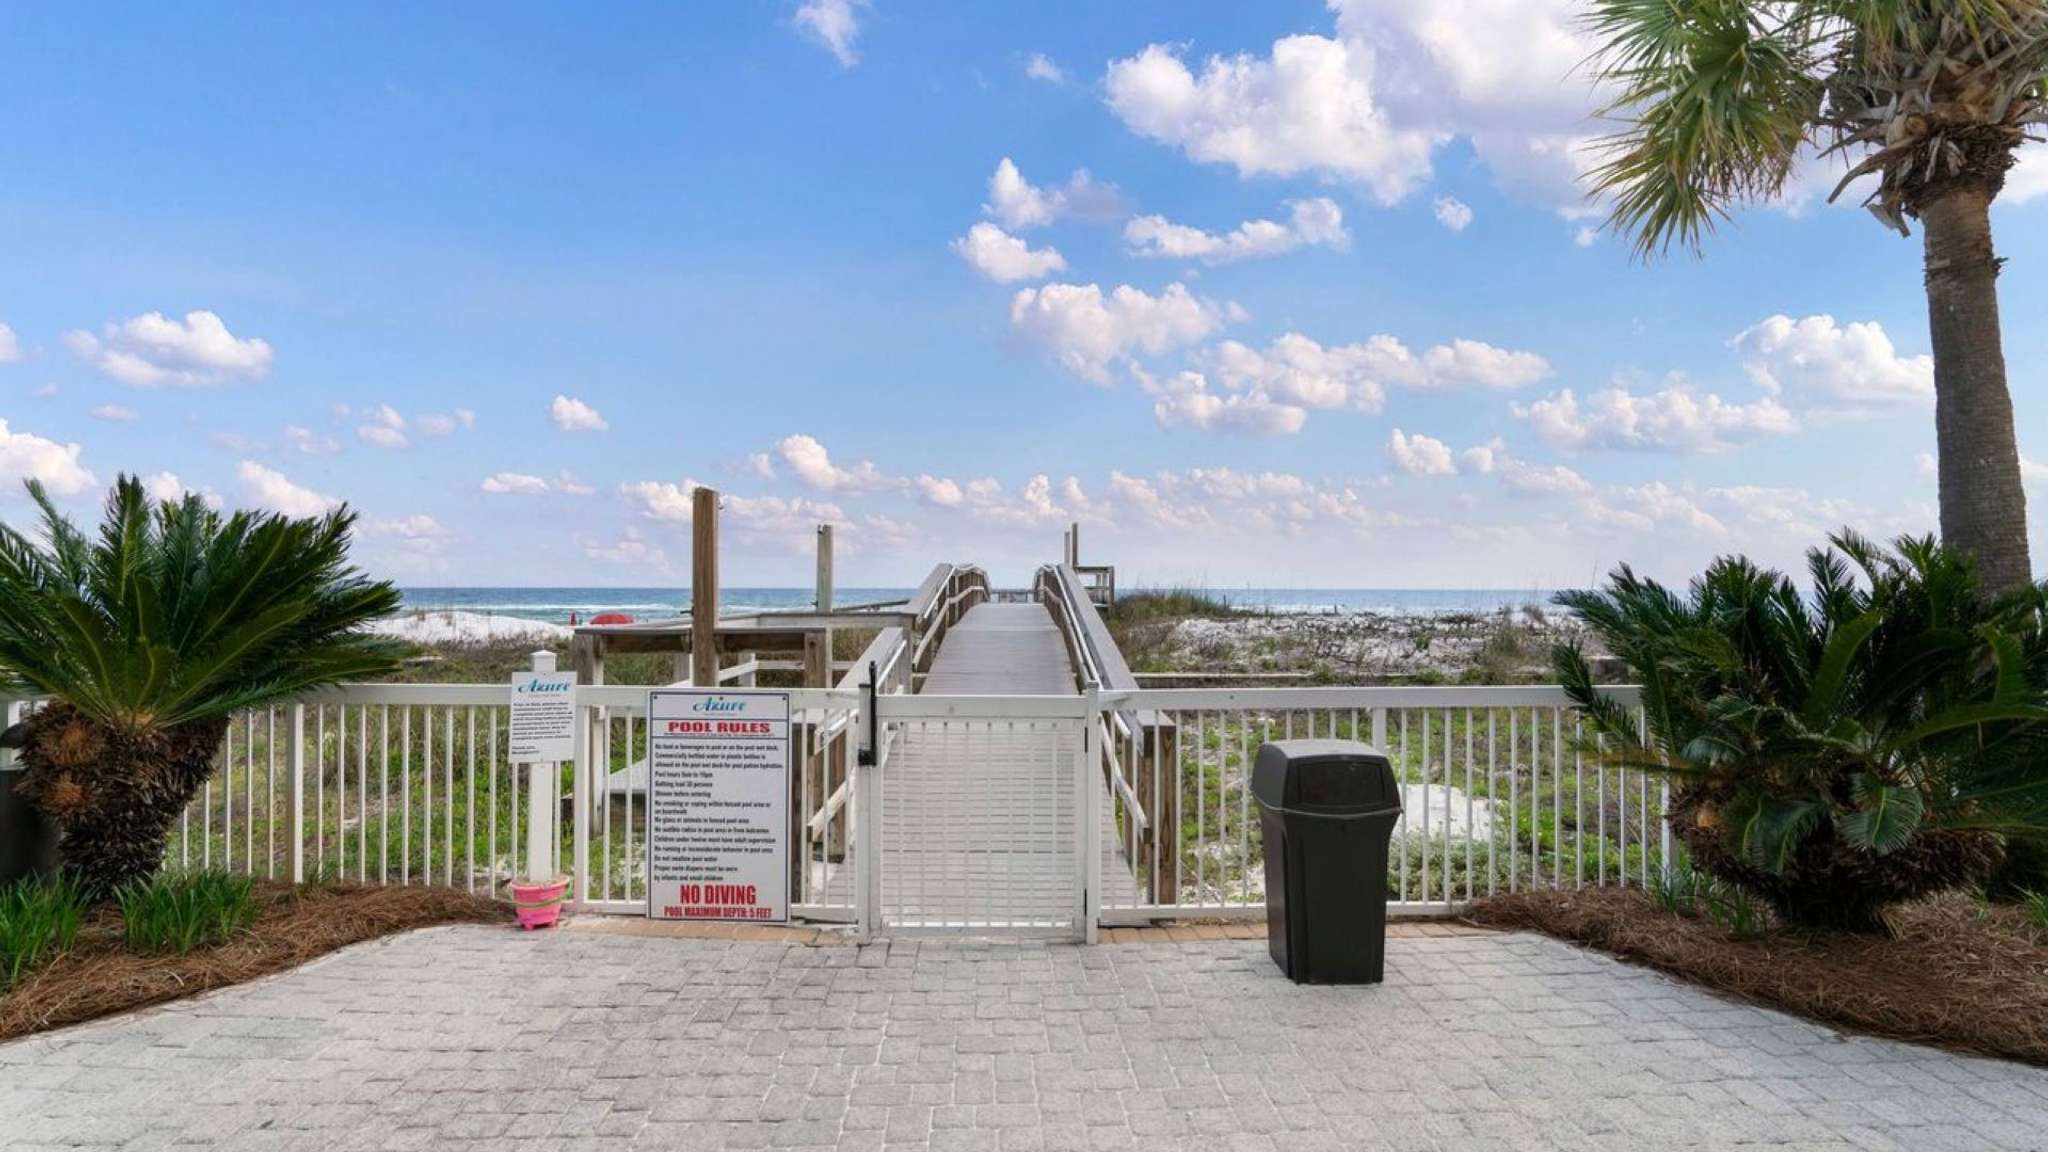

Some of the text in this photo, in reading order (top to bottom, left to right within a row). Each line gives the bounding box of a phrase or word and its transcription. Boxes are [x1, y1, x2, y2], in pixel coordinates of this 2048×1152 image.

[517, 679, 571, 693] Azure
[692, 696, 746, 711] Azure
[668, 721, 771, 733] POOL RULES
[663, 800, 683, 808] smoking
[742, 801, 752, 809] pool
[726, 817, 737, 825] pool
[680, 884, 756, 905] NO DIVING
[664, 906, 682, 917] POOL
[685, 907, 722, 917] MAXIMUM
[756, 908, 772, 918] FEET
